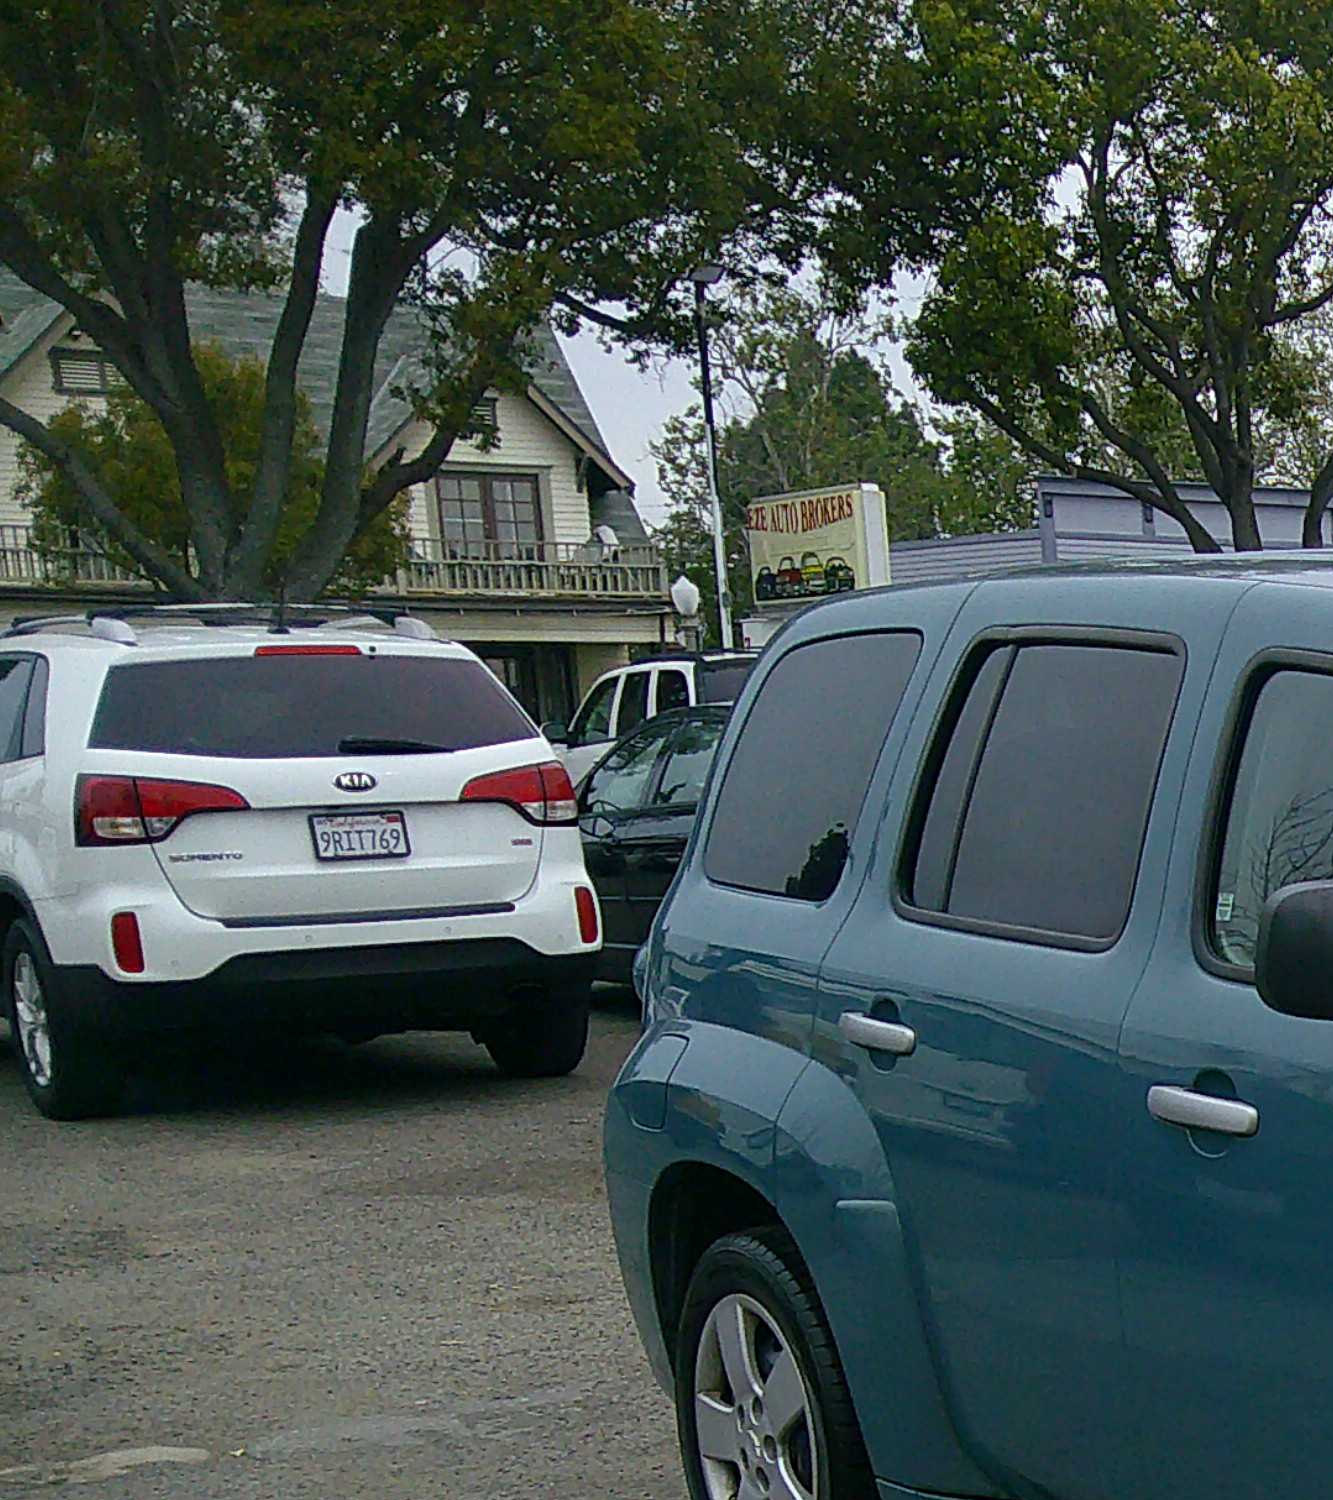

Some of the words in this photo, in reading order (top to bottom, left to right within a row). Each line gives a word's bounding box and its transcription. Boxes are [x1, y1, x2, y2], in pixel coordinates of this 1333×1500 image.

[770, 501, 799, 534] AUTO
[800, 493, 854, 533] BROKERS
[339, 773, 373, 788] KIA
[320, 828, 401, 853] 9RIT769
